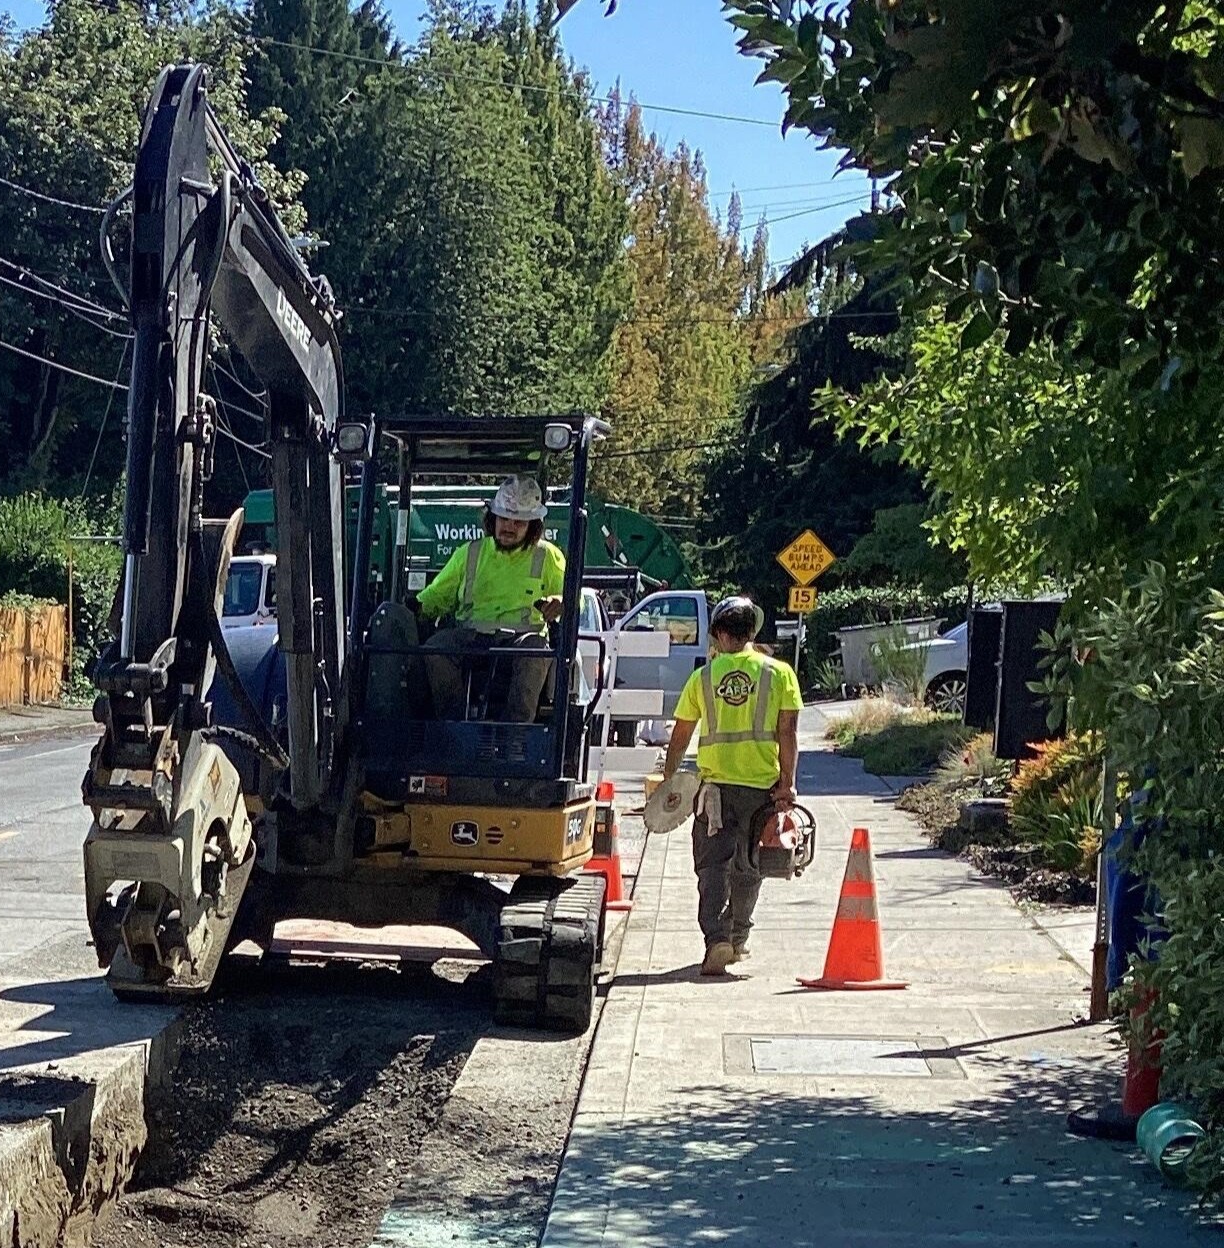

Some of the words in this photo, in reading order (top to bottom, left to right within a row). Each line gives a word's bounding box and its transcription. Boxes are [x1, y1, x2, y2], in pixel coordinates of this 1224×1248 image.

[277, 290, 311, 353] DEERE
[434, 523, 485, 540] Workin
[437, 544, 453, 555] For
[792, 544, 823, 553] SPEED
[788, 553, 824, 562] BUMPS
[790, 562, 822, 572] AHEAD
[794, 590, 811, 603] 15
